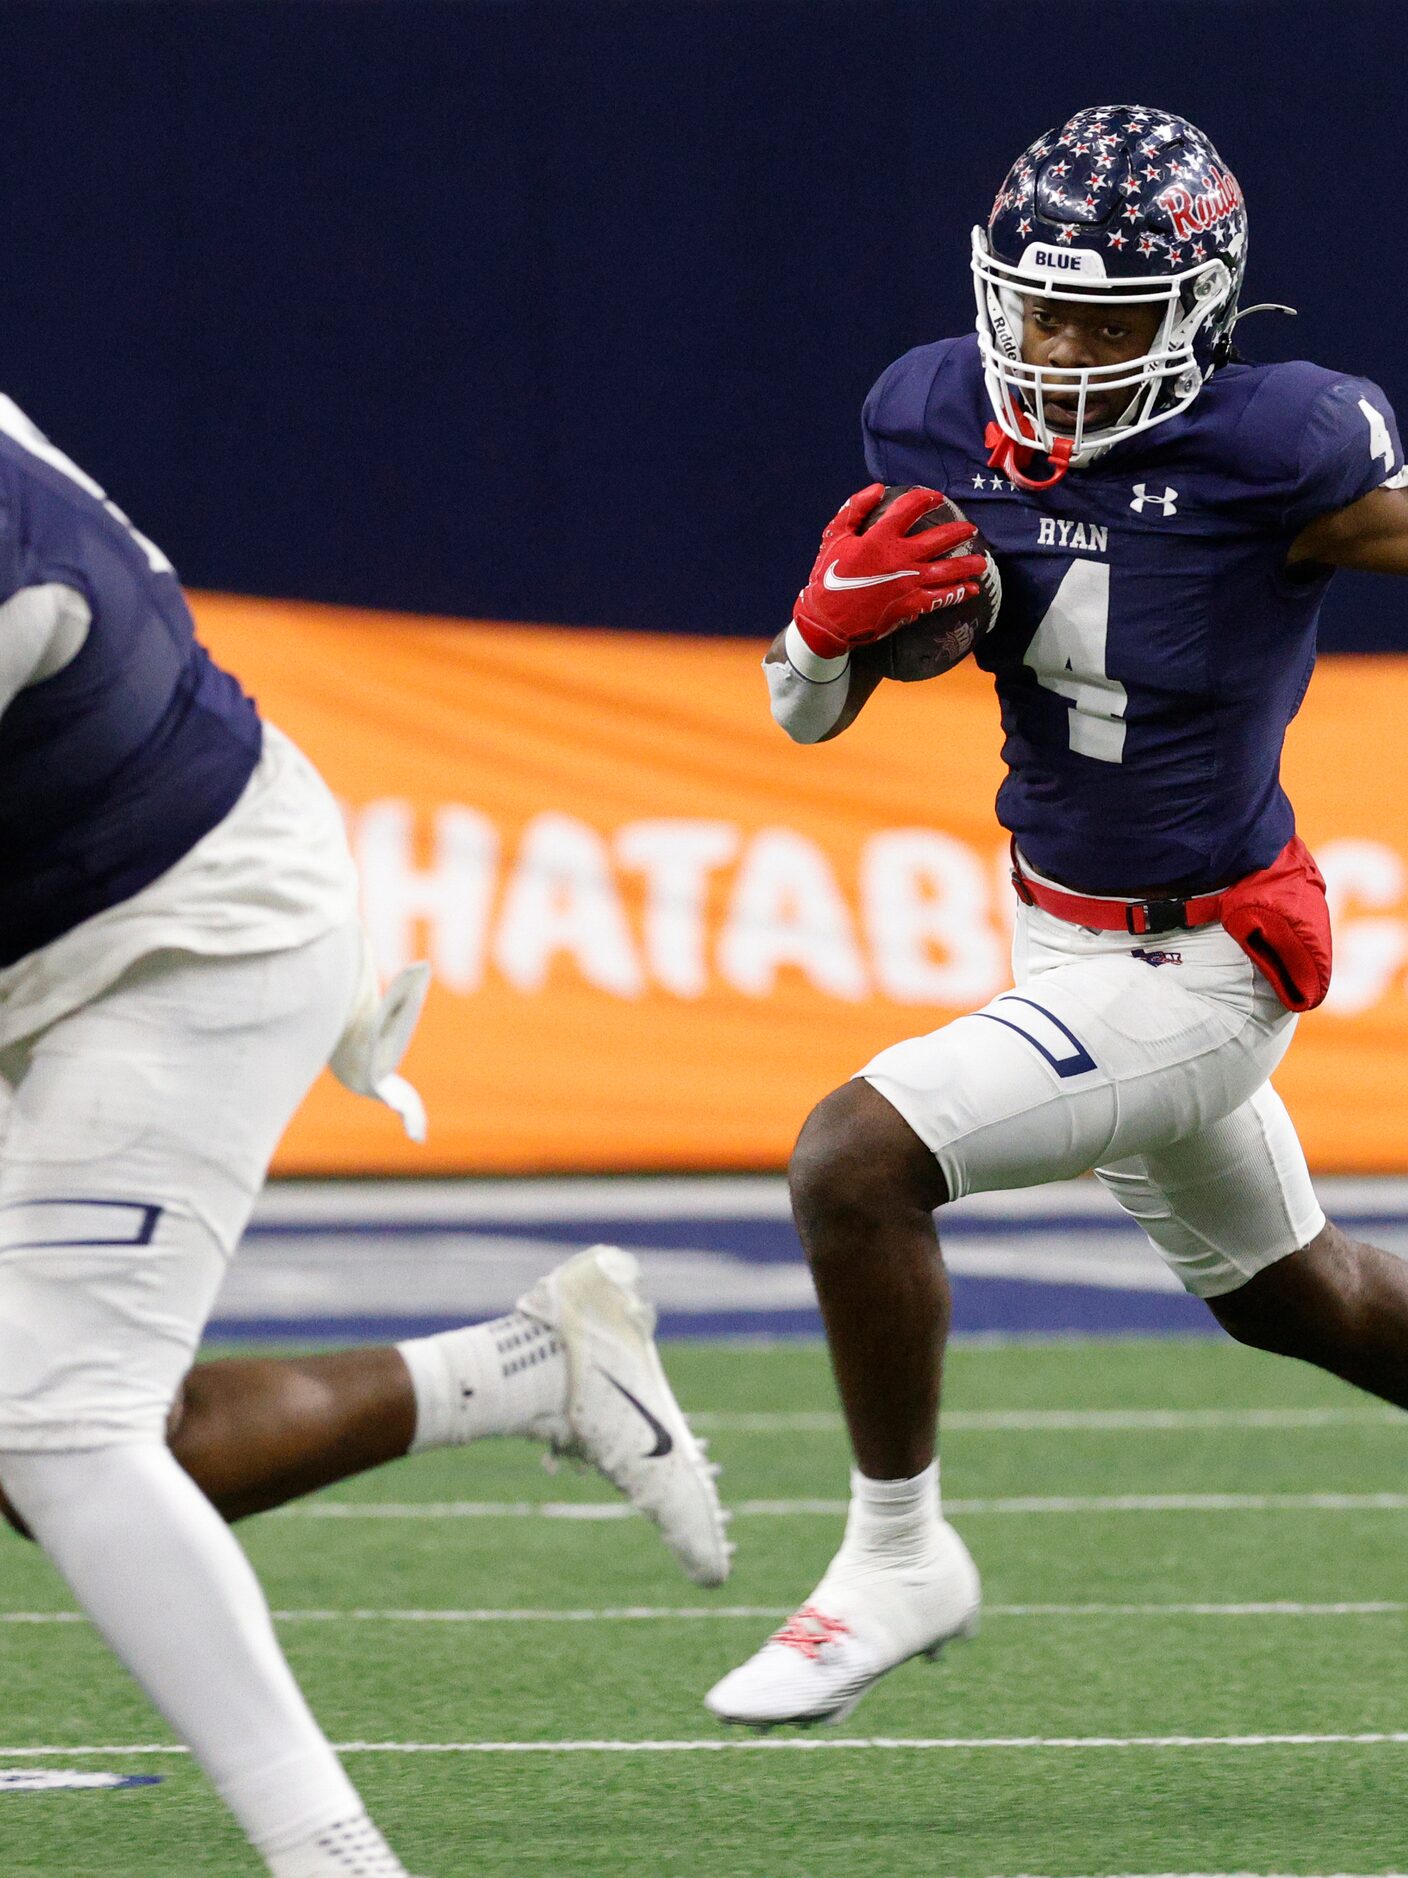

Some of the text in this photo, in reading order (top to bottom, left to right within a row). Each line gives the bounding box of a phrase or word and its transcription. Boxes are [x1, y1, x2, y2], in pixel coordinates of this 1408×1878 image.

[1035, 249, 1082, 271] BLUE
[1357, 398, 1395, 473] 4
[1036, 517, 1108, 552] RYAN
[1023, 558, 1128, 764] 4
